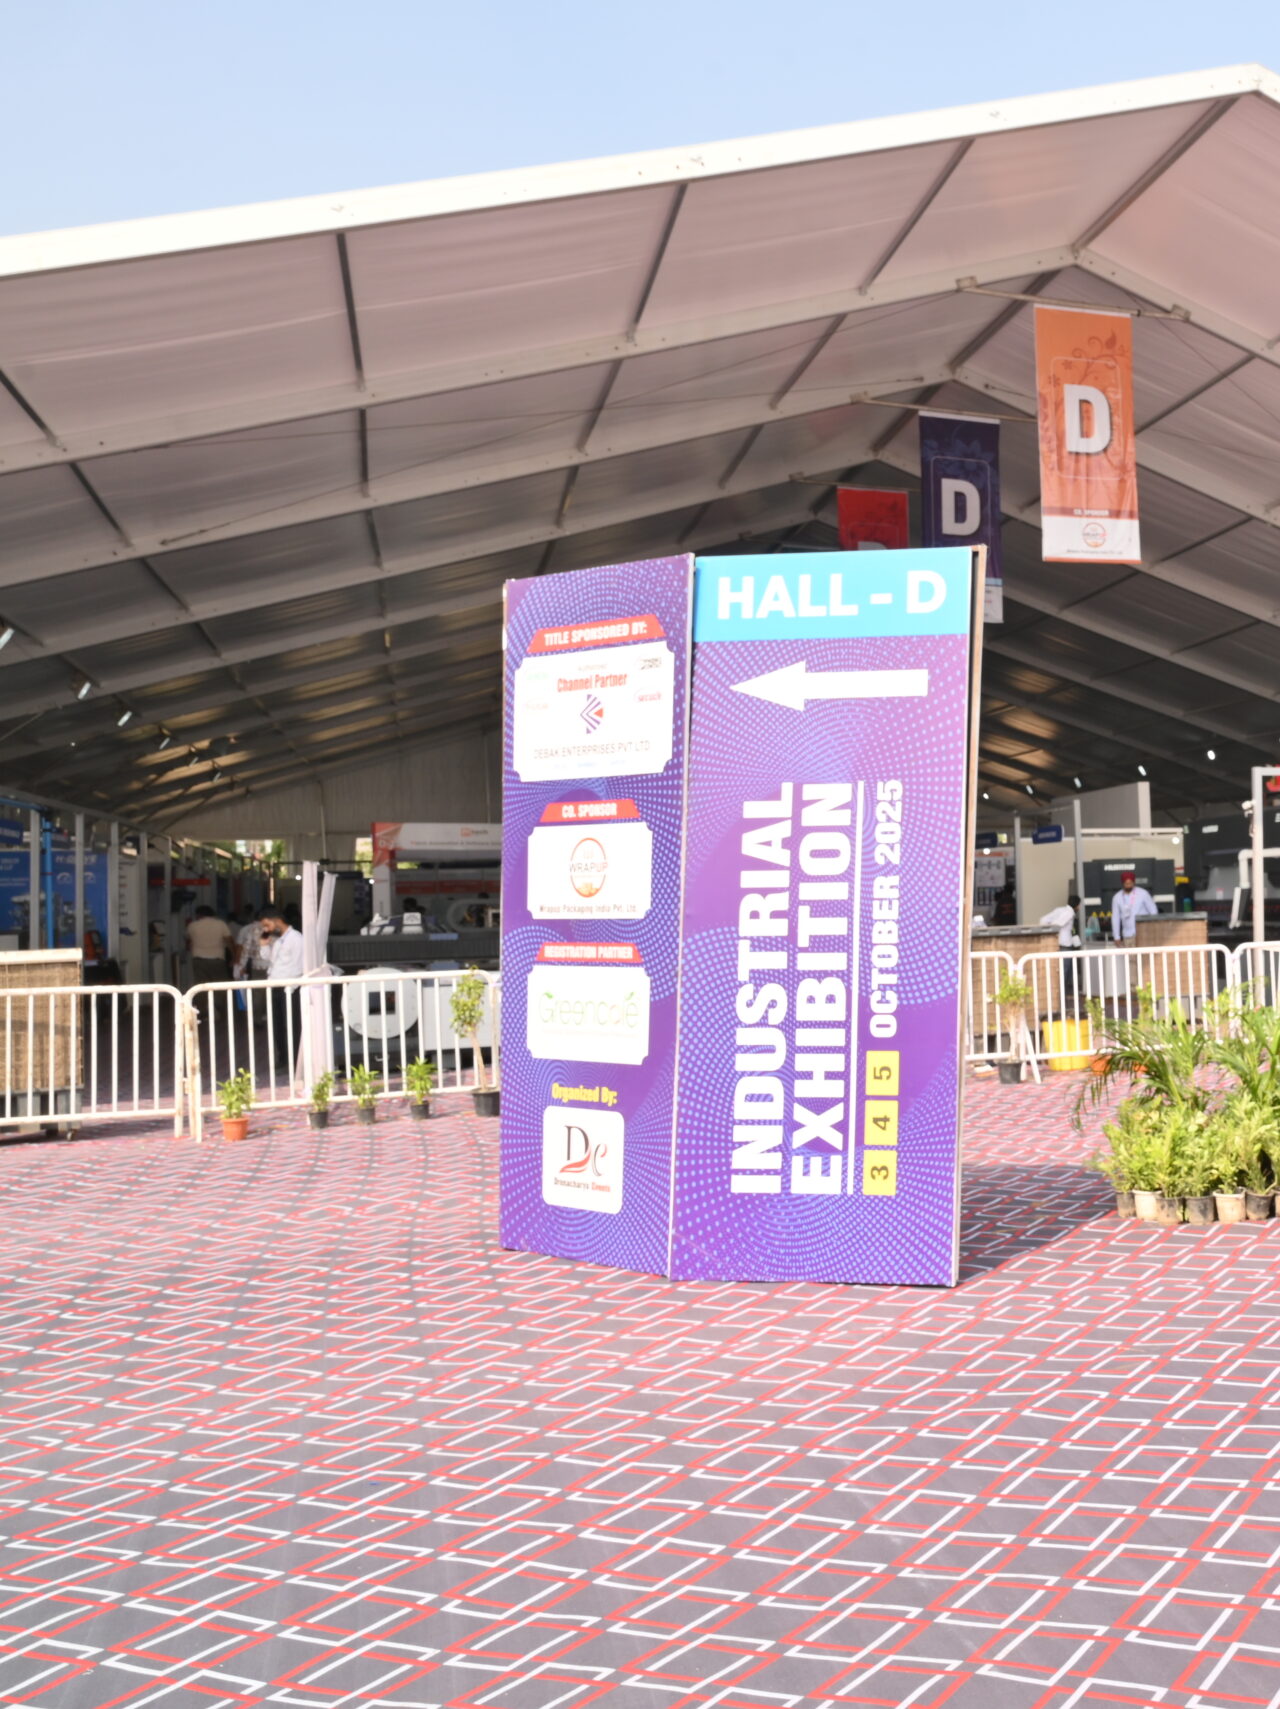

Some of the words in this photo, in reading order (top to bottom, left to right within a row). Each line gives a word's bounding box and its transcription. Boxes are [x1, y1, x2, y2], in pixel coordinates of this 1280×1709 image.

[1063, 384, 1112, 454] D
[941, 478, 981, 536] D
[717, 573, 859, 619] HALL
[906, 570, 947, 614] D
[544, 631, 569, 646] TITLE
[571, 623, 629, 643] SPONSORED
[632, 621, 648, 635] BY:
[557, 678, 593, 693] Channel
[595, 673, 627, 688] Partner
[562, 743, 615, 757] ENTERPRISES
[618, 741, 632, 752] PVT
[635, 740, 650, 751] LTD
[578, 803, 617, 817] SPONSOR
[874, 779, 903, 865] 2025
[569, 862, 608, 873] WRAPUP
[598, 947, 633, 958] PARTNER
[869, 875, 899, 1038] OCTOBER
[730, 782, 794, 1195] INDUSTRIAL
[790, 783, 853, 1195] EXHIBITION
[873, 1065, 892, 1081] 5
[552, 1083, 599, 1102] Organized
[601, 1087, 618, 1106] By:
[872, 1114, 890, 1131] 4
[871, 1165, 889, 1181] 3
